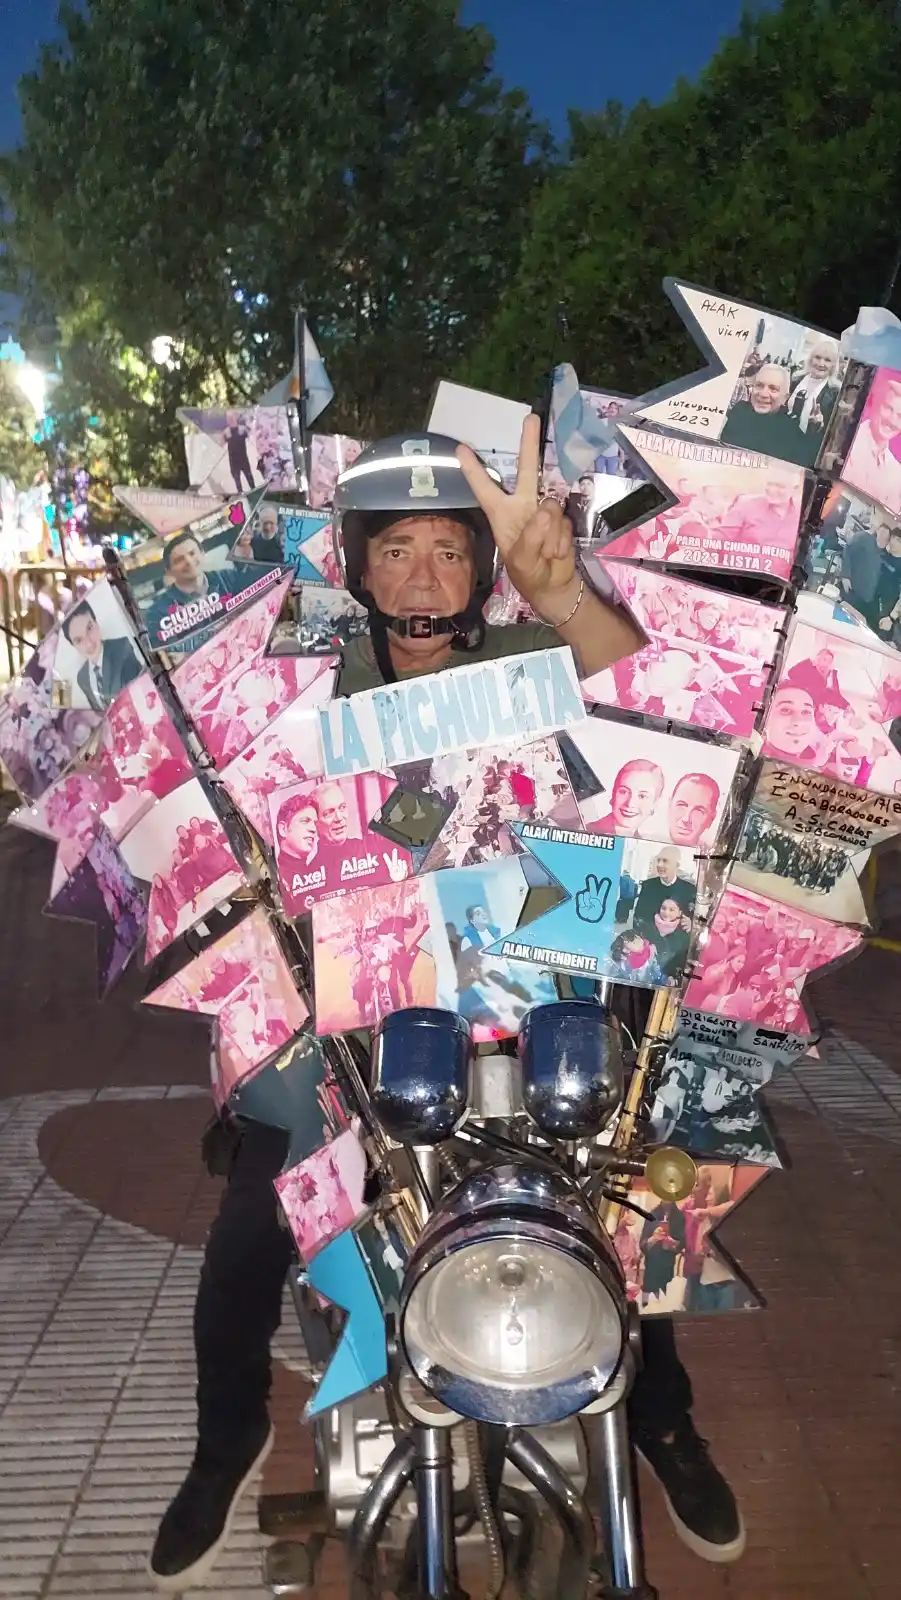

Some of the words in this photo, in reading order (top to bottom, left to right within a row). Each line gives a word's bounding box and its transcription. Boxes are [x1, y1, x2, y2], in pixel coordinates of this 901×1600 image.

[701, 300, 739, 319] ALAK
[668, 412, 709, 427] 2023
[635, 432, 674, 456] ALAK
[674, 441, 769, 469] INTENDENTE
[676, 535, 701, 547] PARA
[702, 538, 722, 550] UNA
[723, 541, 760, 554] CIUDAD
[761, 545, 791, 564] MEJOR
[684, 549, 720, 565] 2023
[722, 554, 760, 570] LISTA
[763, 559, 773, 572] 2
[160, 591, 220, 631] CIUDAD
[319, 703, 371, 774] LA
[371, 652, 585, 763] PICHULETA
[772, 771, 868, 803] INUNDACION
[771, 785, 890, 828] COLABORADORES
[522, 824, 549, 840] ALAK
[551, 829, 615, 850] INTENDENTE
[292, 865, 326, 890] Axel
[340, 853, 379, 874] Alak
[501, 941, 531, 959] ALAK
[533, 946, 598, 971] INTENDENTE
